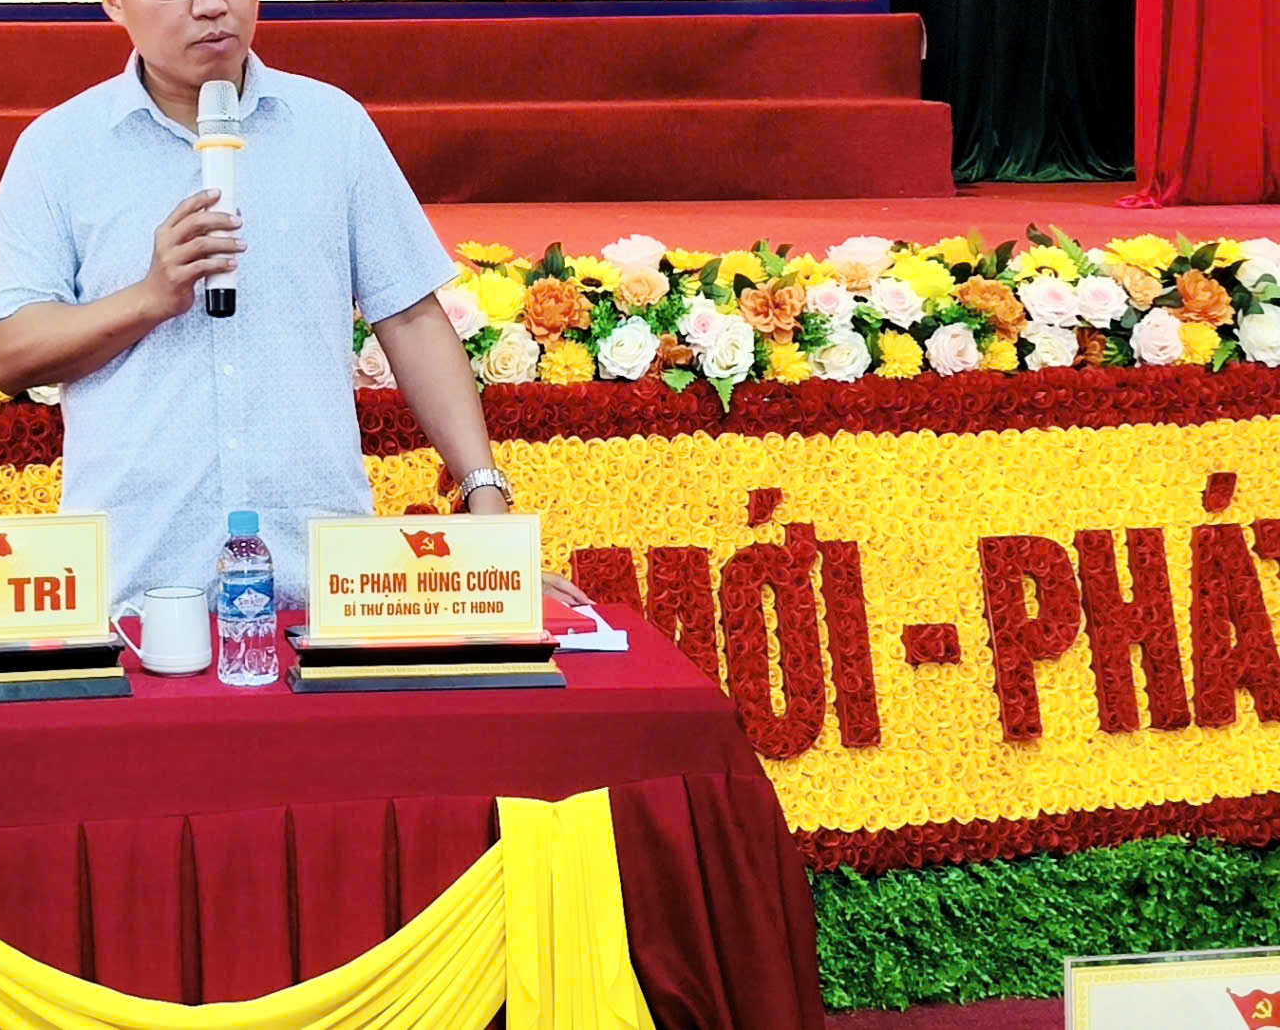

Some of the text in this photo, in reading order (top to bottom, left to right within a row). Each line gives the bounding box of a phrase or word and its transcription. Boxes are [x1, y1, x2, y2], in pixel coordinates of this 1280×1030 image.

[7, 567, 76, 612] TRÌ
[360, 573, 407, 598] PHẠM
[417, 567, 461, 593] HÙNG
[467, 566, 521, 592] CƯỜNG
